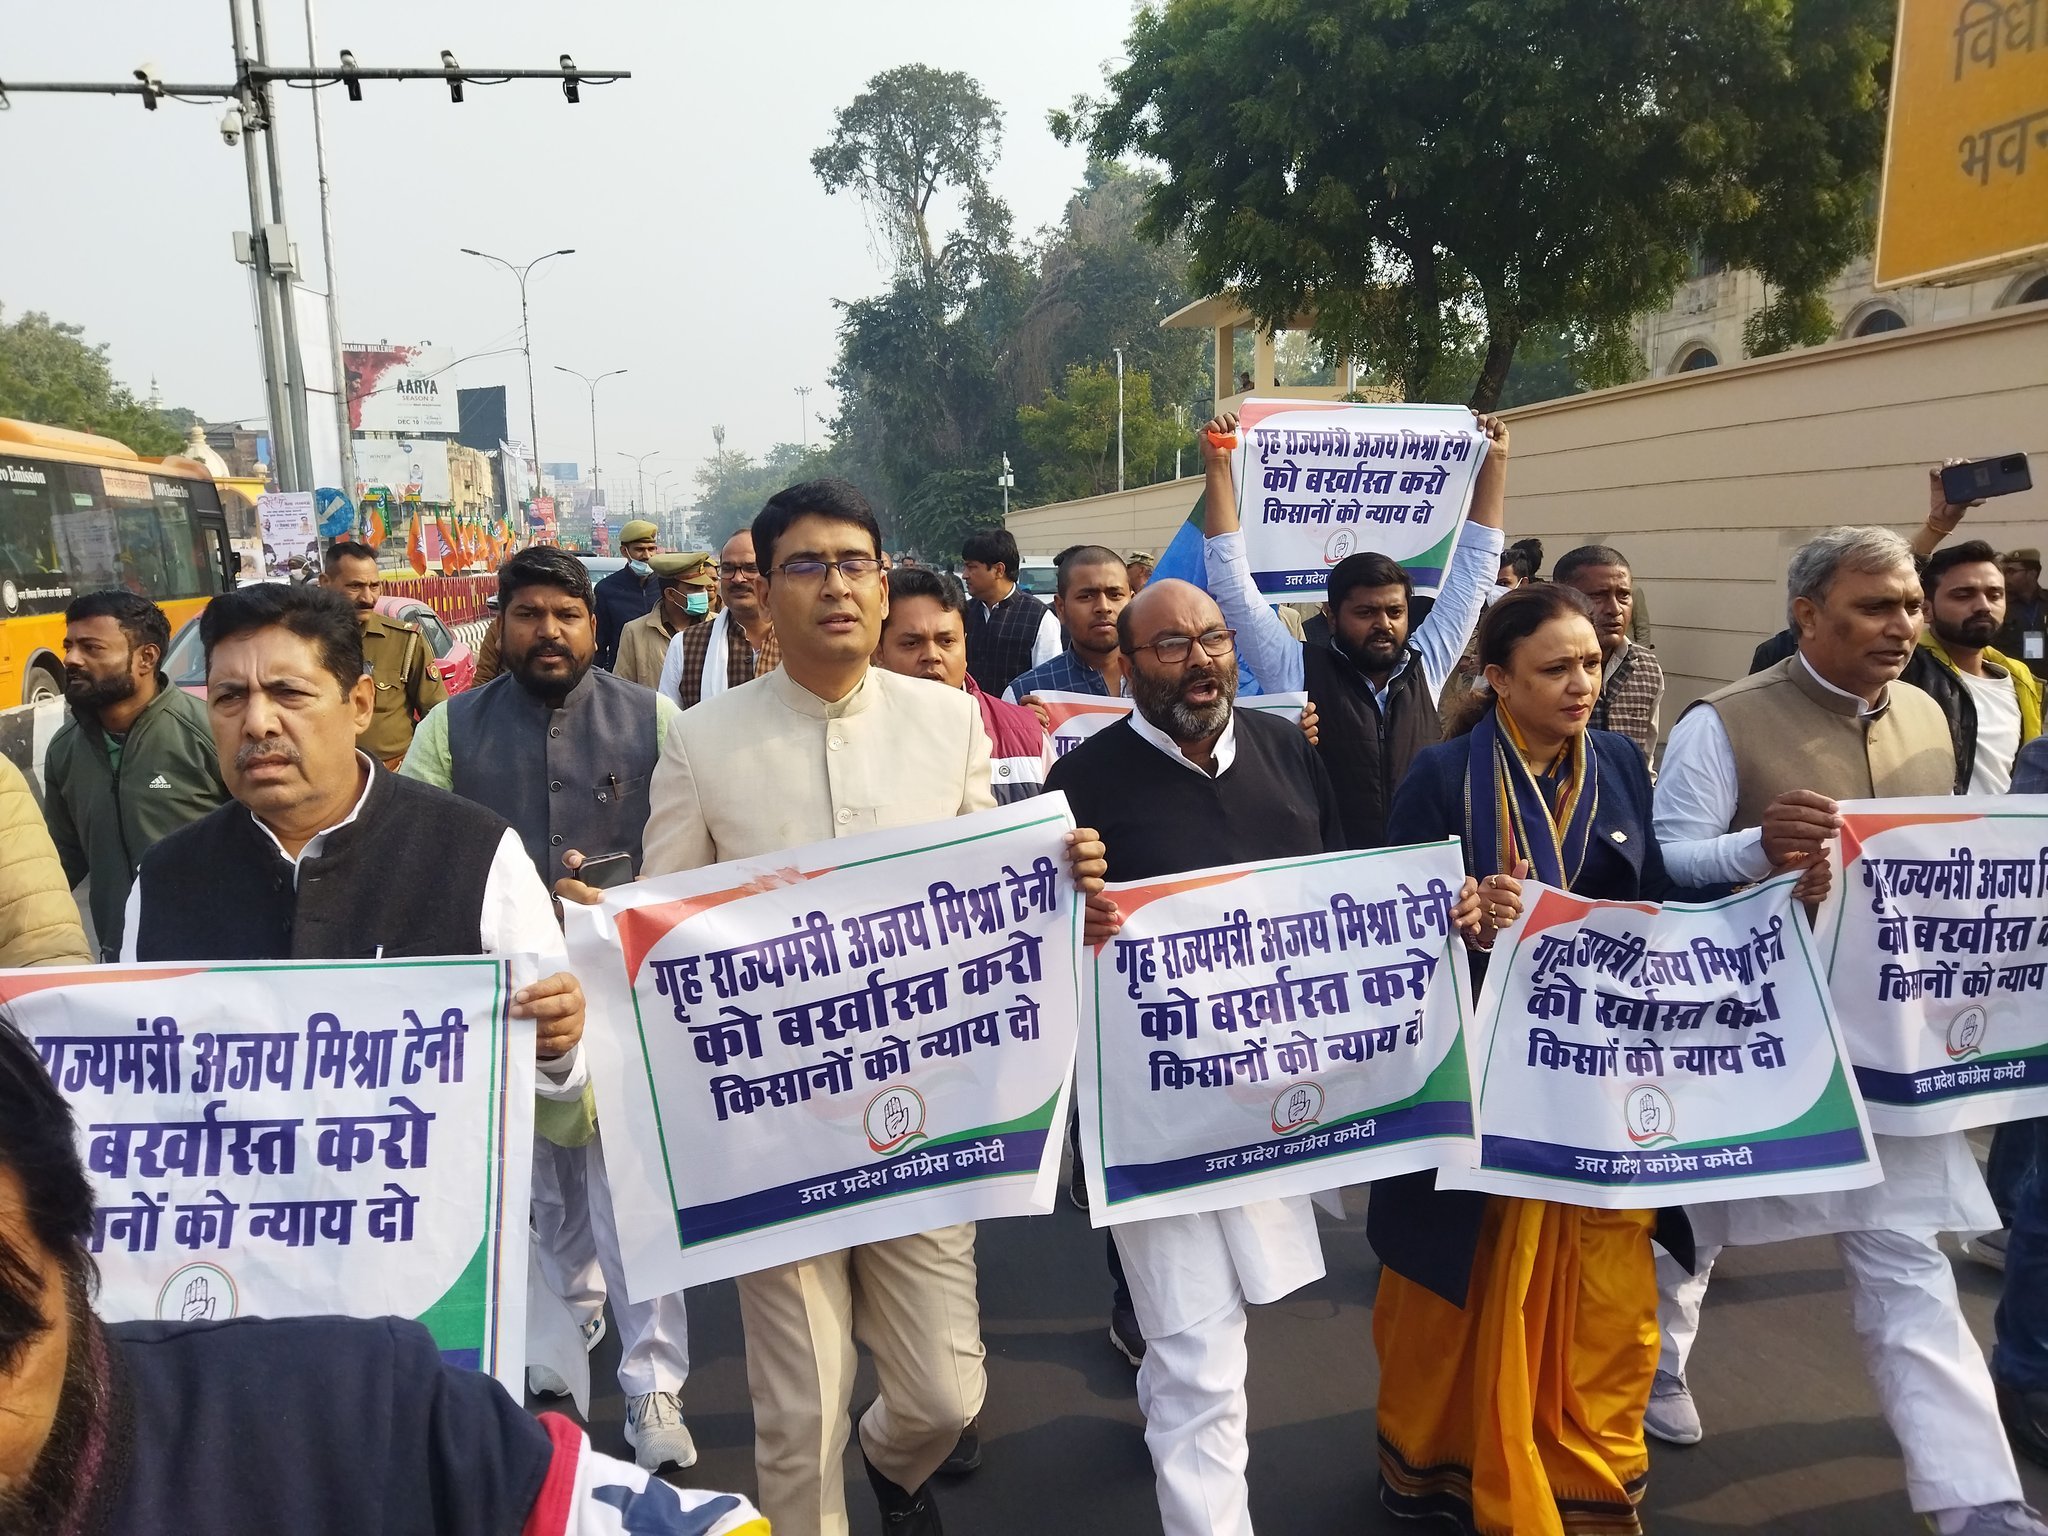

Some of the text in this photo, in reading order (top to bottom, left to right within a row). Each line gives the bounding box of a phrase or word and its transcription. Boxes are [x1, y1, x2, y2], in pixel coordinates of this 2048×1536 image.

[396, 379, 439, 395] AARYA
[1255, 429, 1473, 464] गृह राज्यमंत्री अजय मिश्रा टेनी
[6, 465, 47, 484] Emission
[1263, 459, 1302, 492] को
[1399, 465, 1450, 494] करो
[1263, 497, 1434, 524] किसानों को न्याय दो
[1285, 571, 1329, 587] उत्तर प्रदेश
[1977, 859, 2035, 899] अजय
[649, 857, 1058, 1023] गृह राज्यमंत्री अजय मिश्रा टेनी
[1114, 879, 1457, 1000] गृह राज्यमंत्री अजय मिश्रा टेनी
[687, 930, 1043, 1066] को बर्खास्त करो
[1138, 948, 1439, 1041] को बर्खास्त करो
[1527, 972, 1586, 1026] को
[1962, 962, 1996, 998] को
[1997, 963, 2048, 992] न्याय
[191, 1033, 299, 1093] अजय
[304, 1013, 398, 1089] मिश्रा
[402, 1008, 469, 1084] टेनी
[710, 994, 1040, 1121] किसानों को न्याय दो
[1149, 1009, 1424, 1091] किसानों को न्याय दो
[1624, 1038, 1664, 1077] को
[1670, 1045, 1743, 1075] न्याय
[1747, 1032, 1786, 1069] दो
[1915, 1060, 2026, 1094] उत्तर प्रदेश कांग्रेस कमेटी
[89, 1096, 436, 1178] बर्खास्त करो
[1205, 1119, 1376, 1173] उत्तर प्रदेश कांग्रेस कमेटी
[1574, 1147, 1753, 1176] उत्तर प्रदेश कांग्रेस कमेटी
[798, 1139, 1005, 1205] उत्तर प्रदेश कांग्रेस कमेटी
[175, 1190, 240, 1249] को
[249, 1200, 357, 1246] न्याय
[366, 1183, 419, 1242] दो
